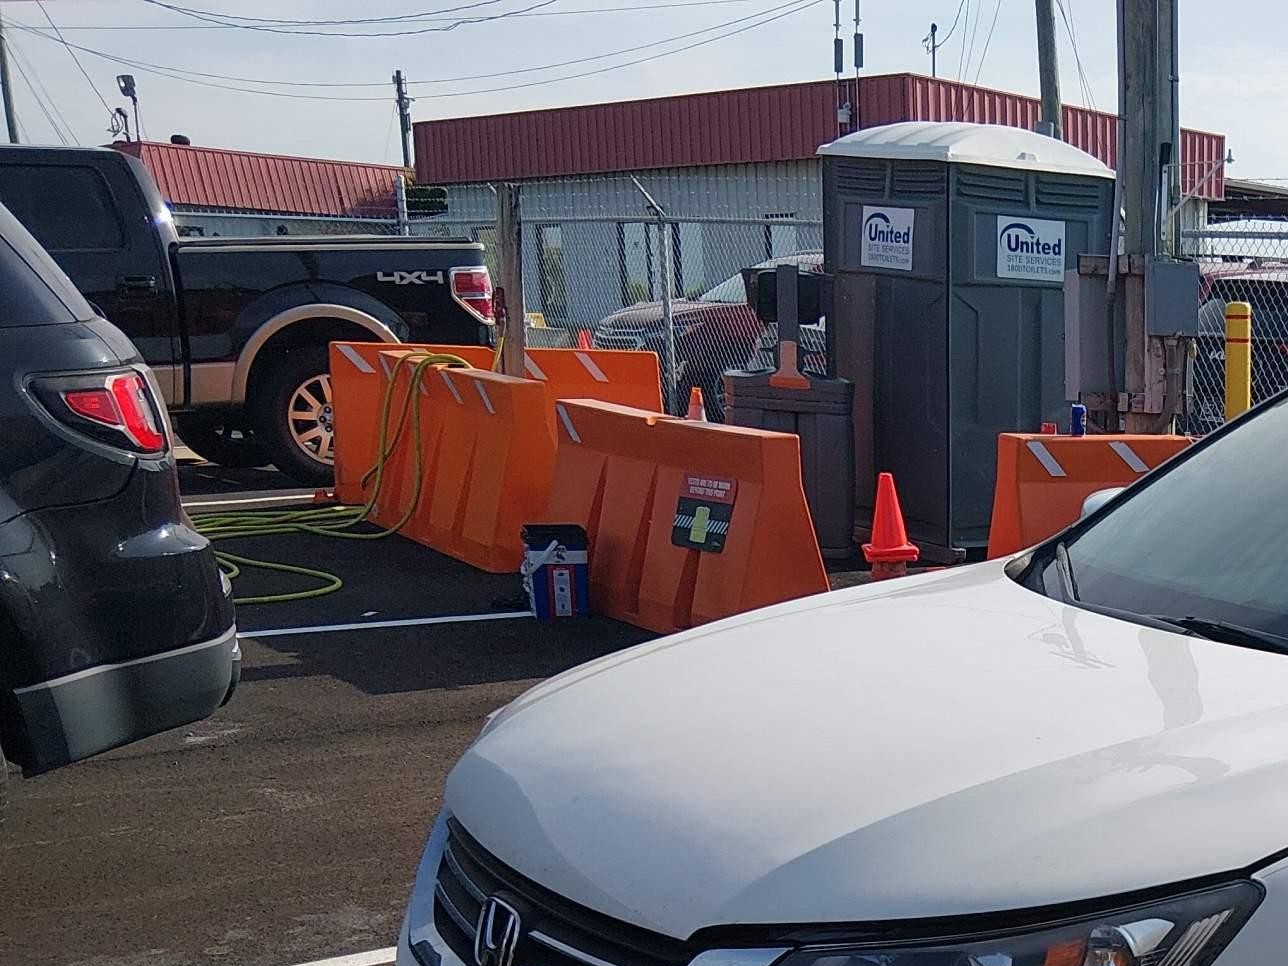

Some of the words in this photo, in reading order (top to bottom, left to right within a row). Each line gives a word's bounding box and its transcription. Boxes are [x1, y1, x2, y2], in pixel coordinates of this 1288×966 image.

[869, 223, 911, 245] United
[1007, 233, 1062, 256] United
[1007, 254, 1023, 264] SITE
[1026, 256, 1062, 267] SERVICES
